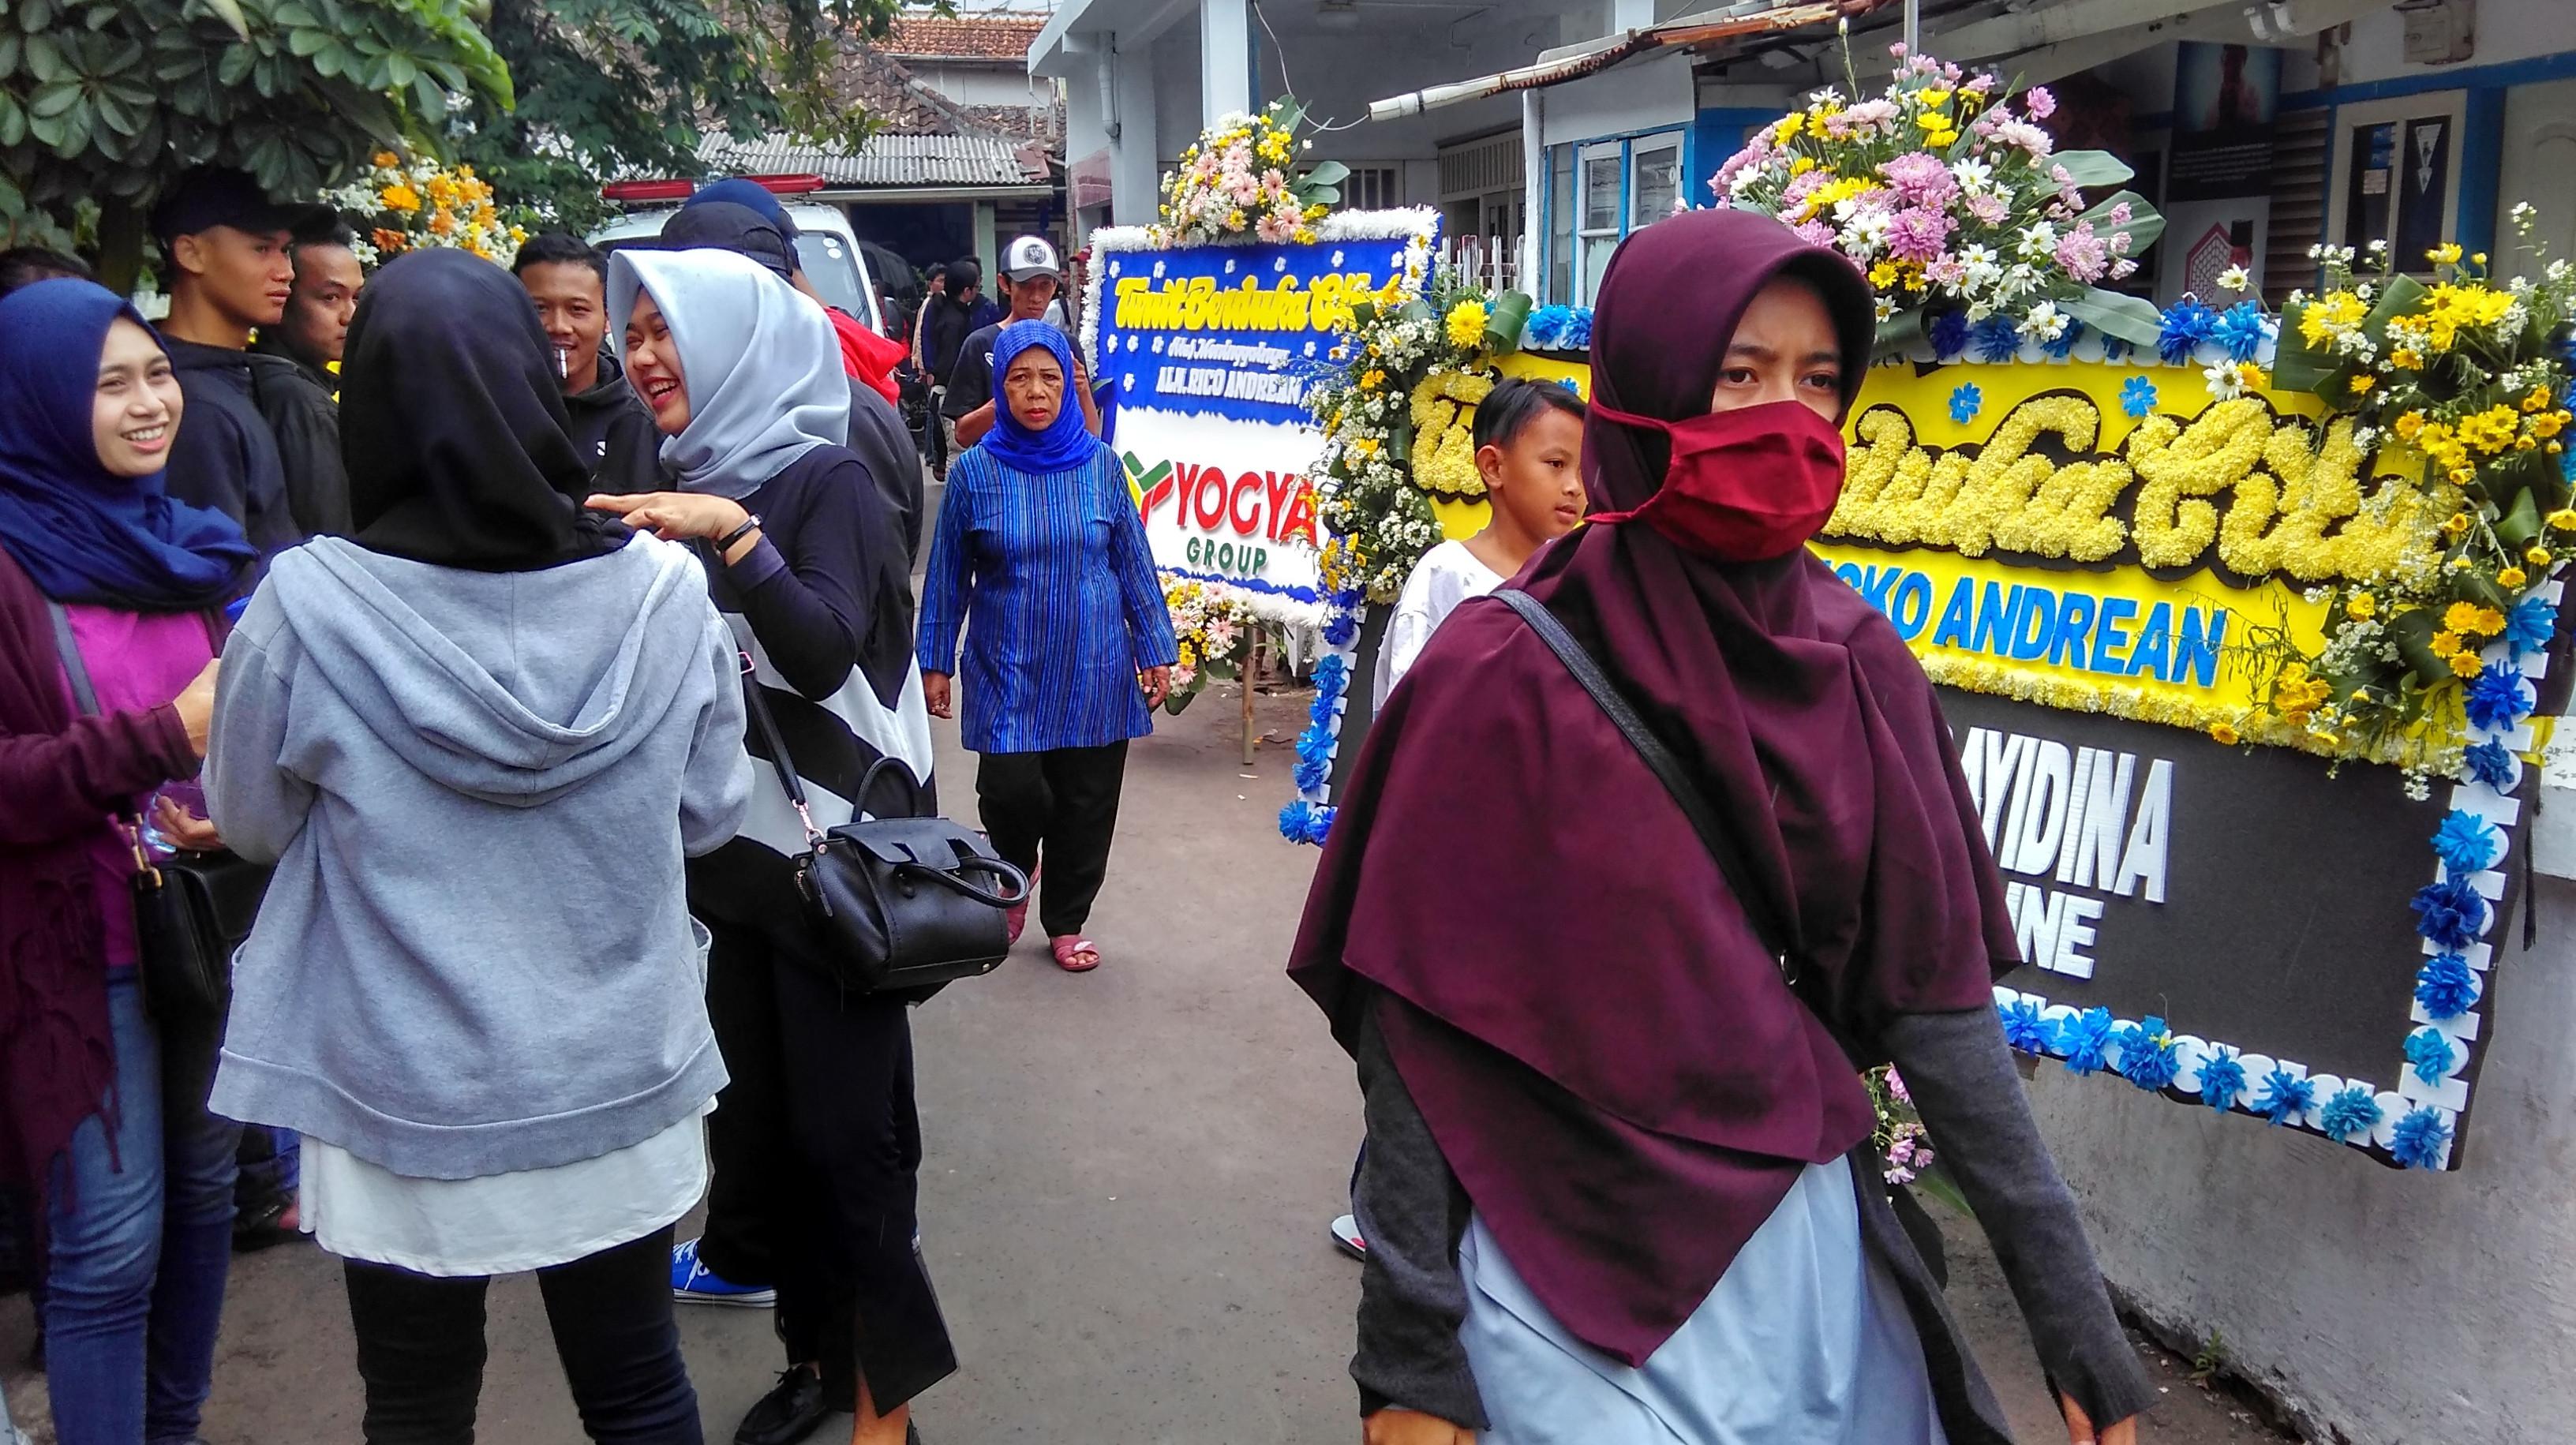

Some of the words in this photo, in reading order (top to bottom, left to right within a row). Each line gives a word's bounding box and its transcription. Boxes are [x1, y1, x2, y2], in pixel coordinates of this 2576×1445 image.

[1184, 275, 1310, 331] Berduka
[1223, 370, 1303, 406] ANDREAN
[1175, 461, 1319, 546] YOGYA
[1186, 536, 1267, 575] GROUP
[1933, 576, 2227, 689] ANDREAN
[1948, 724, 2176, 905] AYIDINA
